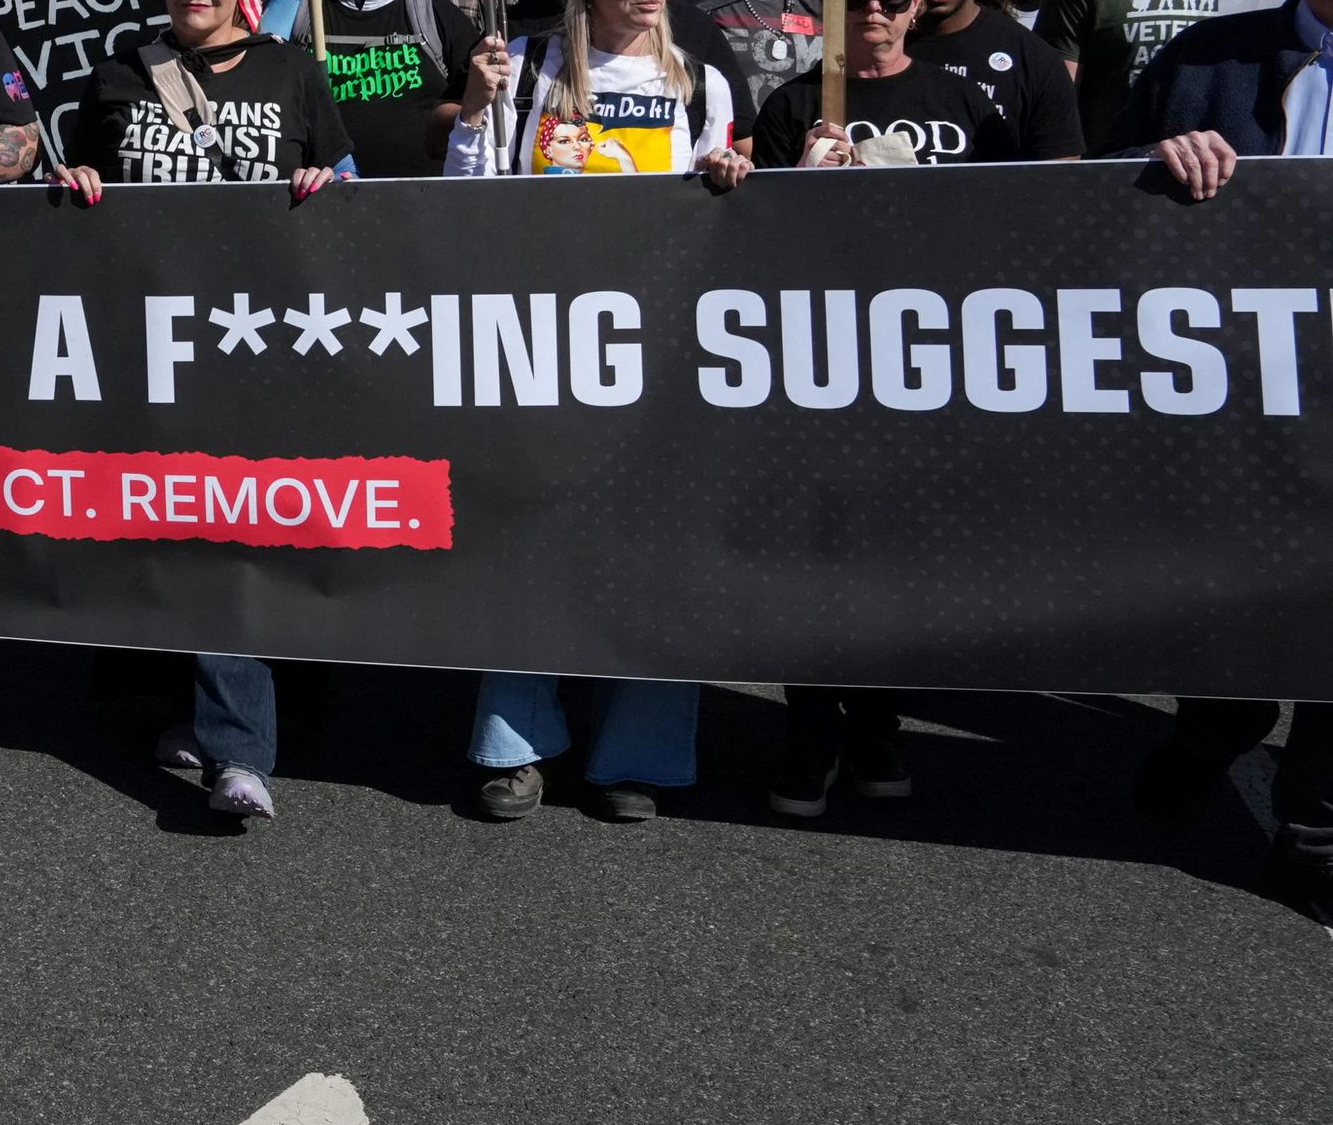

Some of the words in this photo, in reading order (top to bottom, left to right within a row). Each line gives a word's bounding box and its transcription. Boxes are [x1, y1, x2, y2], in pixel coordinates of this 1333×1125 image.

[589, 95, 615, 118] an
[618, 96, 646, 118] Do
[649, 98, 671, 120] It!
[814, 119, 967, 155] OOD
[27, 294, 102, 402] A
[696, 286, 1320, 416] SUGGEST
[120, 473, 422, 530] REMOVE.
